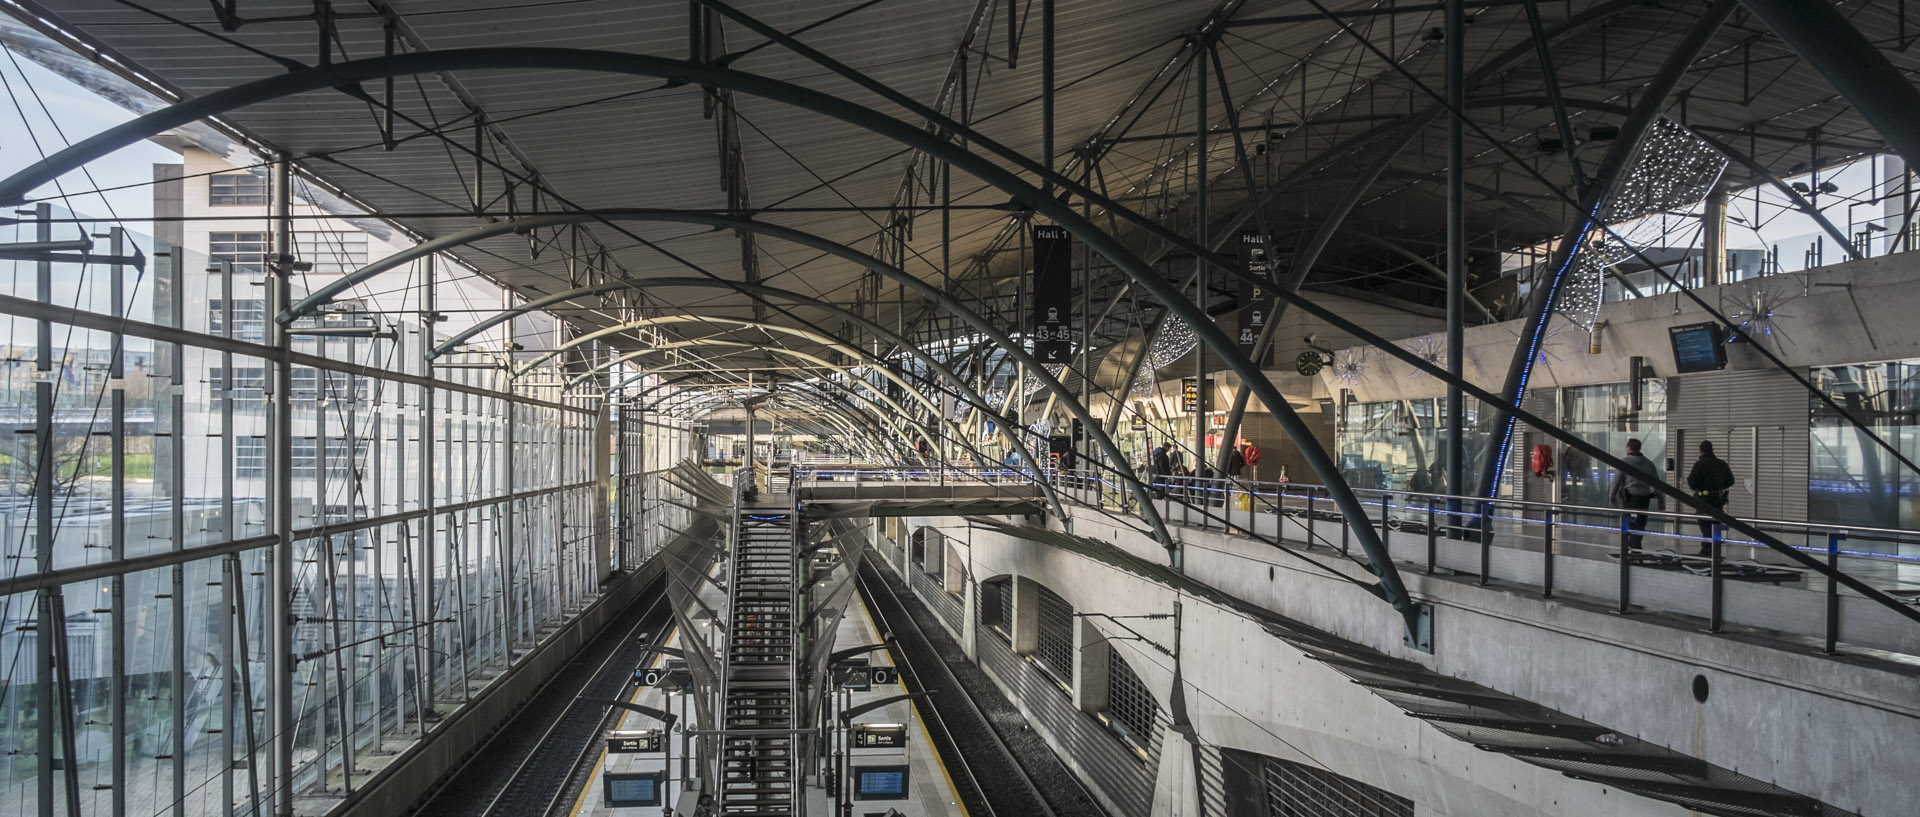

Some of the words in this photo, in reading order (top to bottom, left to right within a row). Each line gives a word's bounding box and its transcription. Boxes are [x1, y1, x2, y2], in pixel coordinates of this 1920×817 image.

[1037, 230, 1058, 239] Hall
[1062, 230, 1067, 239] 1
[1243, 234, 1264, 243] Hall
[1253, 288, 1261, 298] P
[1035, 330, 1049, 340] 43
[1056, 330, 1070, 340] 45
[1240, 332, 1253, 342] 44
